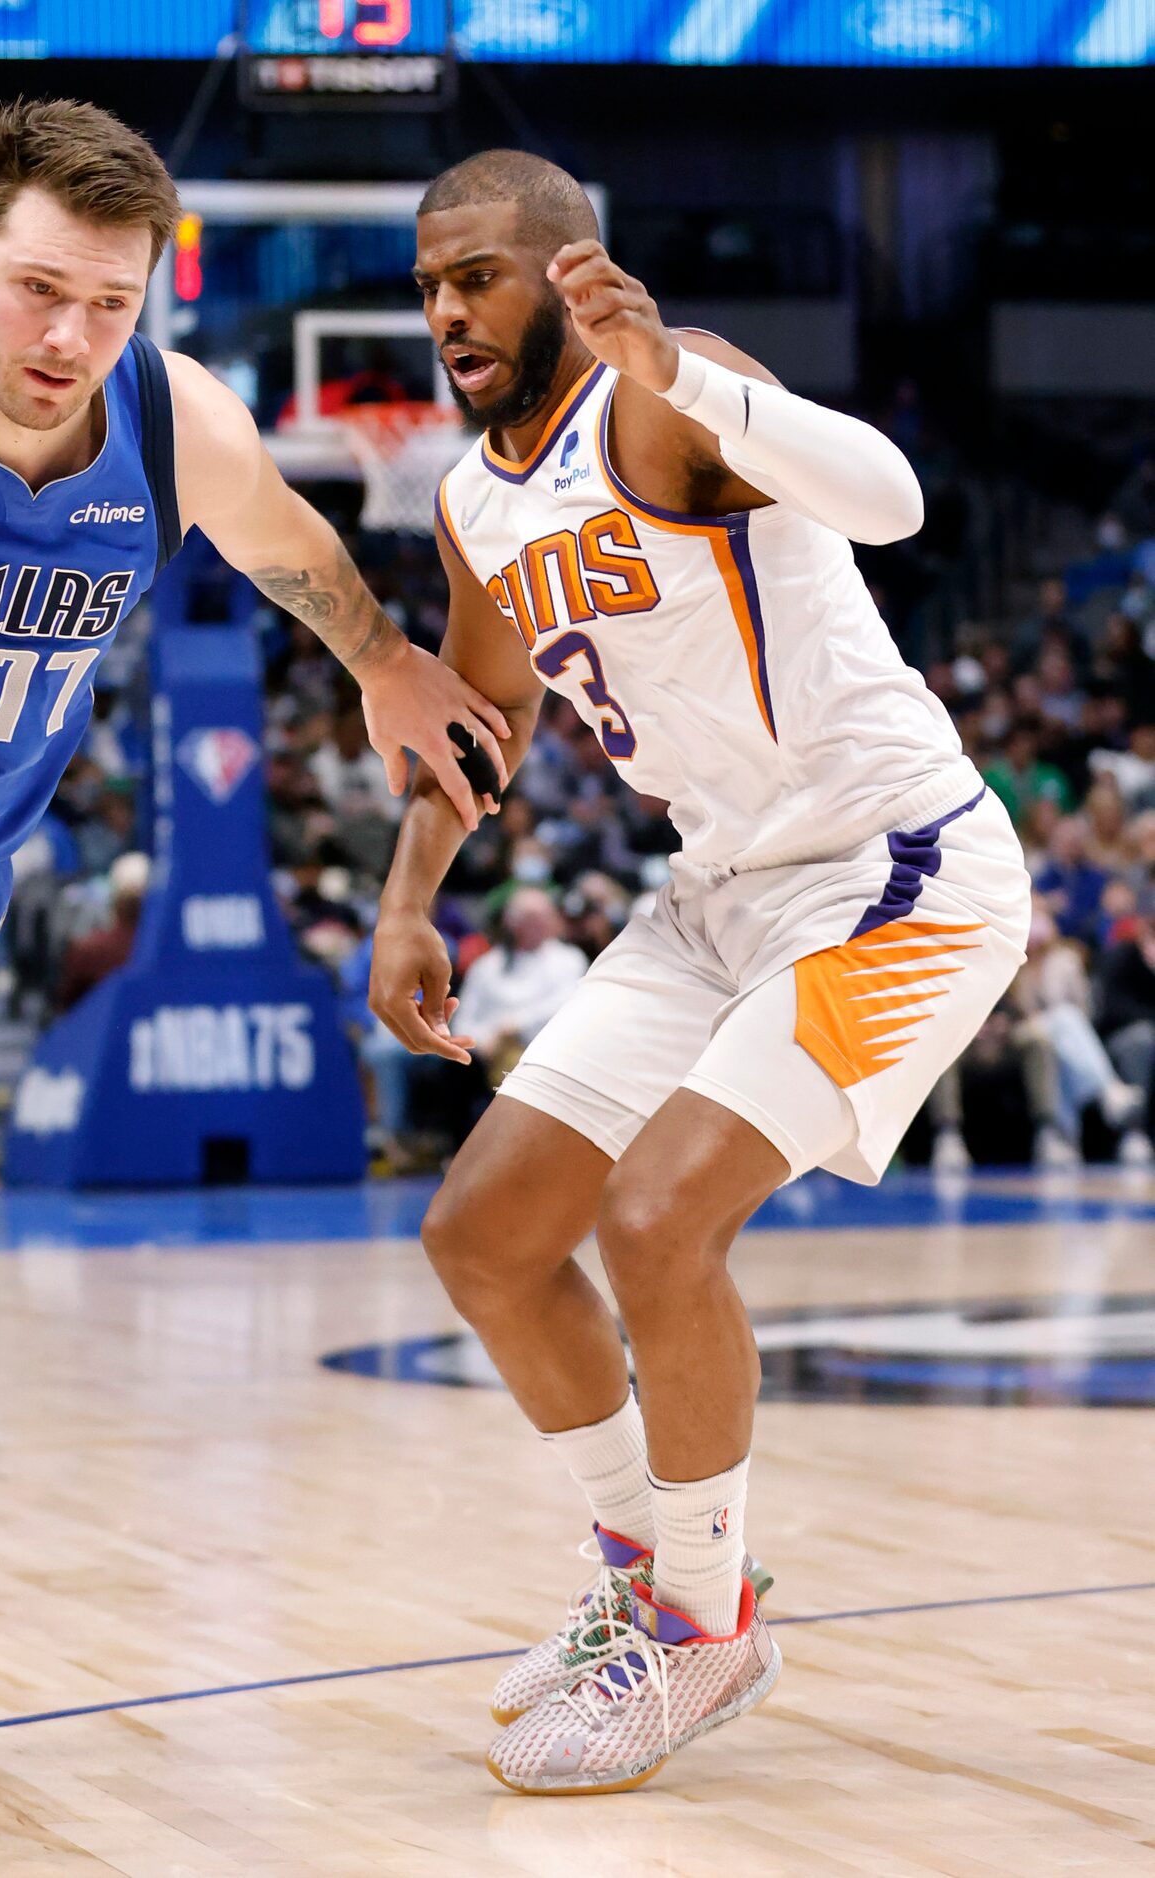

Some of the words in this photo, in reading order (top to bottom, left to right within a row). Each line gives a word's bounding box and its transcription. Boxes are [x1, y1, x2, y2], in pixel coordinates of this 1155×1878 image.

[554, 463, 590, 493] PayPal
[69, 501, 146, 524] chime
[532, 629, 638, 761] 3
